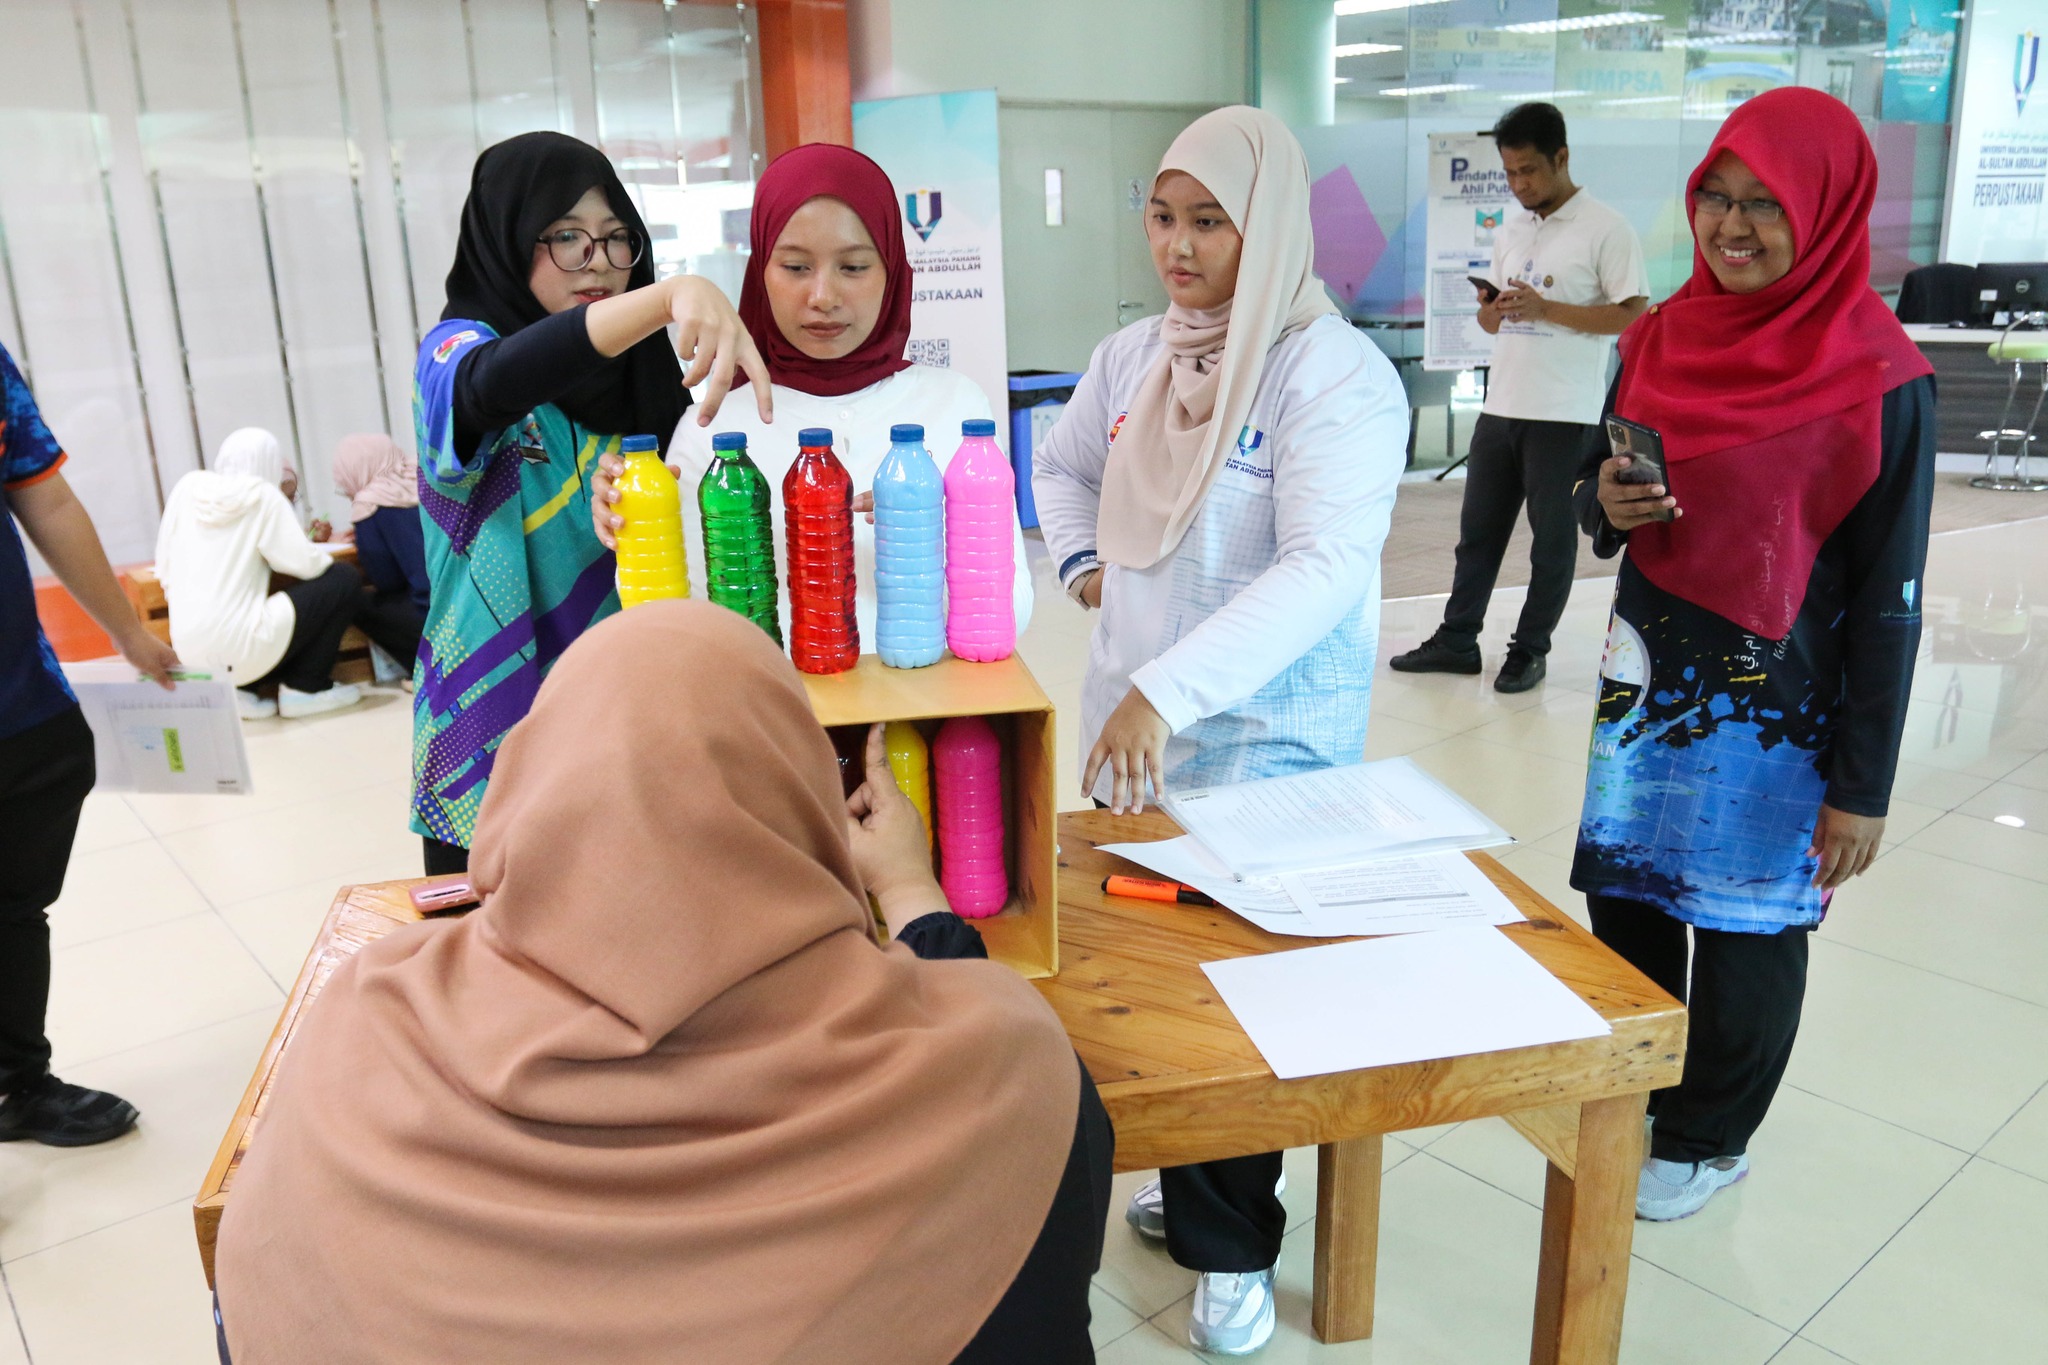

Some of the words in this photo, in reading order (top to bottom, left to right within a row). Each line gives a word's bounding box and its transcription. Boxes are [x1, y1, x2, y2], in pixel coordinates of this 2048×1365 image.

[1577, 70, 1664, 92] UMPSA
[1450, 157, 1506, 182] Pendafta
[1978, 157, 2014, 169] AL-SULTAN
[2015, 157, 2047, 169] ABDULLAH
[1461, 183, 1485, 194] Ahli
[1973, 182, 2044, 206] PERPUSTAKAAN
[913, 257, 950, 265] MALAYSIA
[951, 255, 982, 263] PAHANG
[928, 263, 981, 273] ABDULLAH
[912, 288, 983, 302] USTAKAAN
